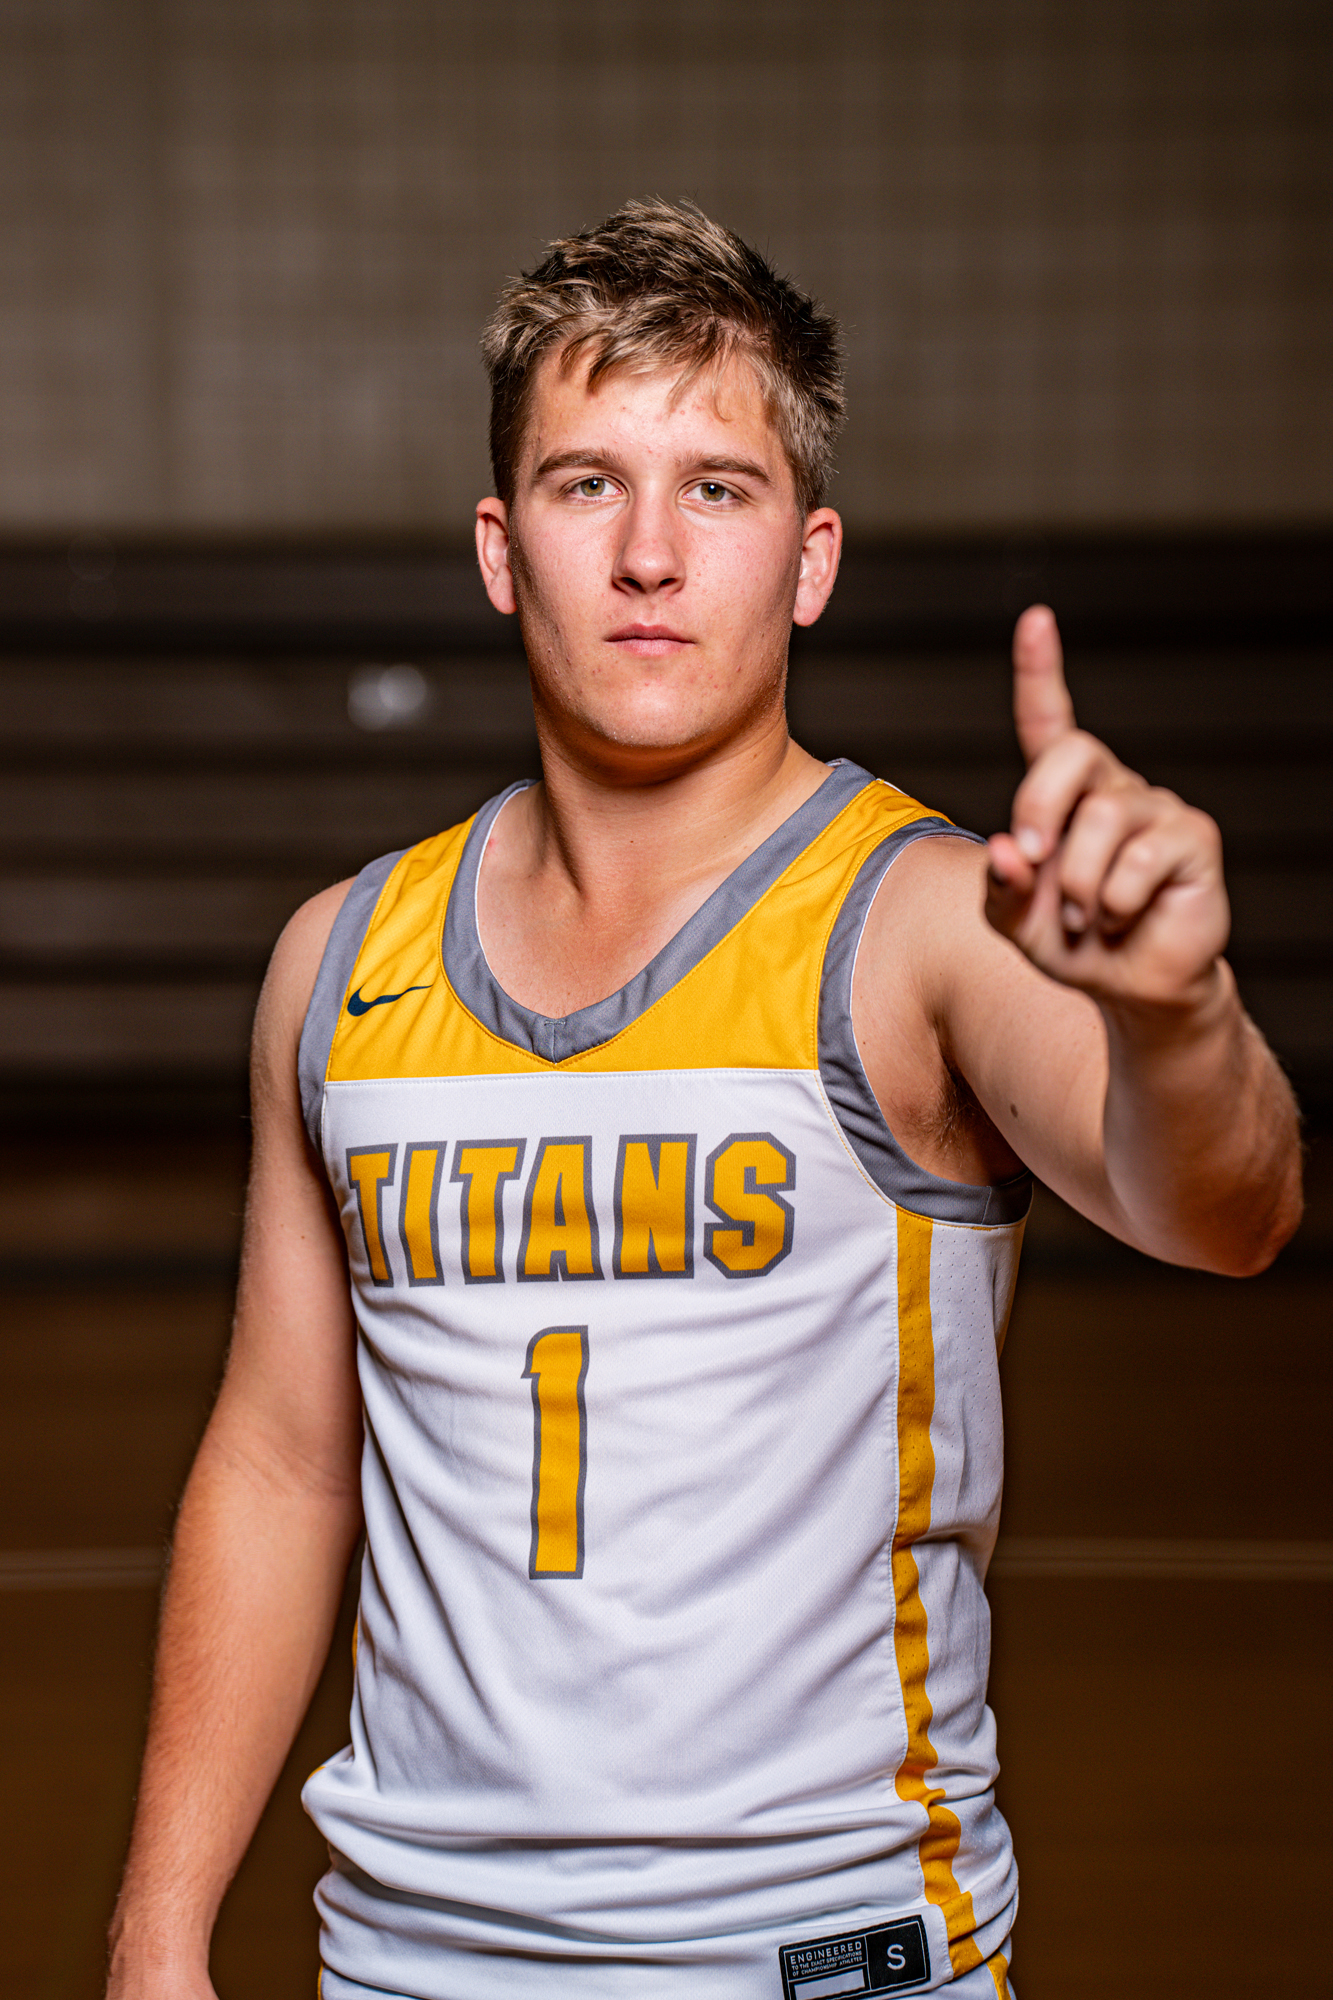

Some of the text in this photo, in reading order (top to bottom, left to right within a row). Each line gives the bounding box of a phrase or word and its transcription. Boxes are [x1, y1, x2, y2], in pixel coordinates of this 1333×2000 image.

[346, 1132, 796, 1288] TITANS
[520, 1324, 589, 1580] 1
[790, 1941, 862, 1965] ENGINEERED
[810, 1959, 825, 1967] EXACT
[886, 1943, 906, 1970] S
